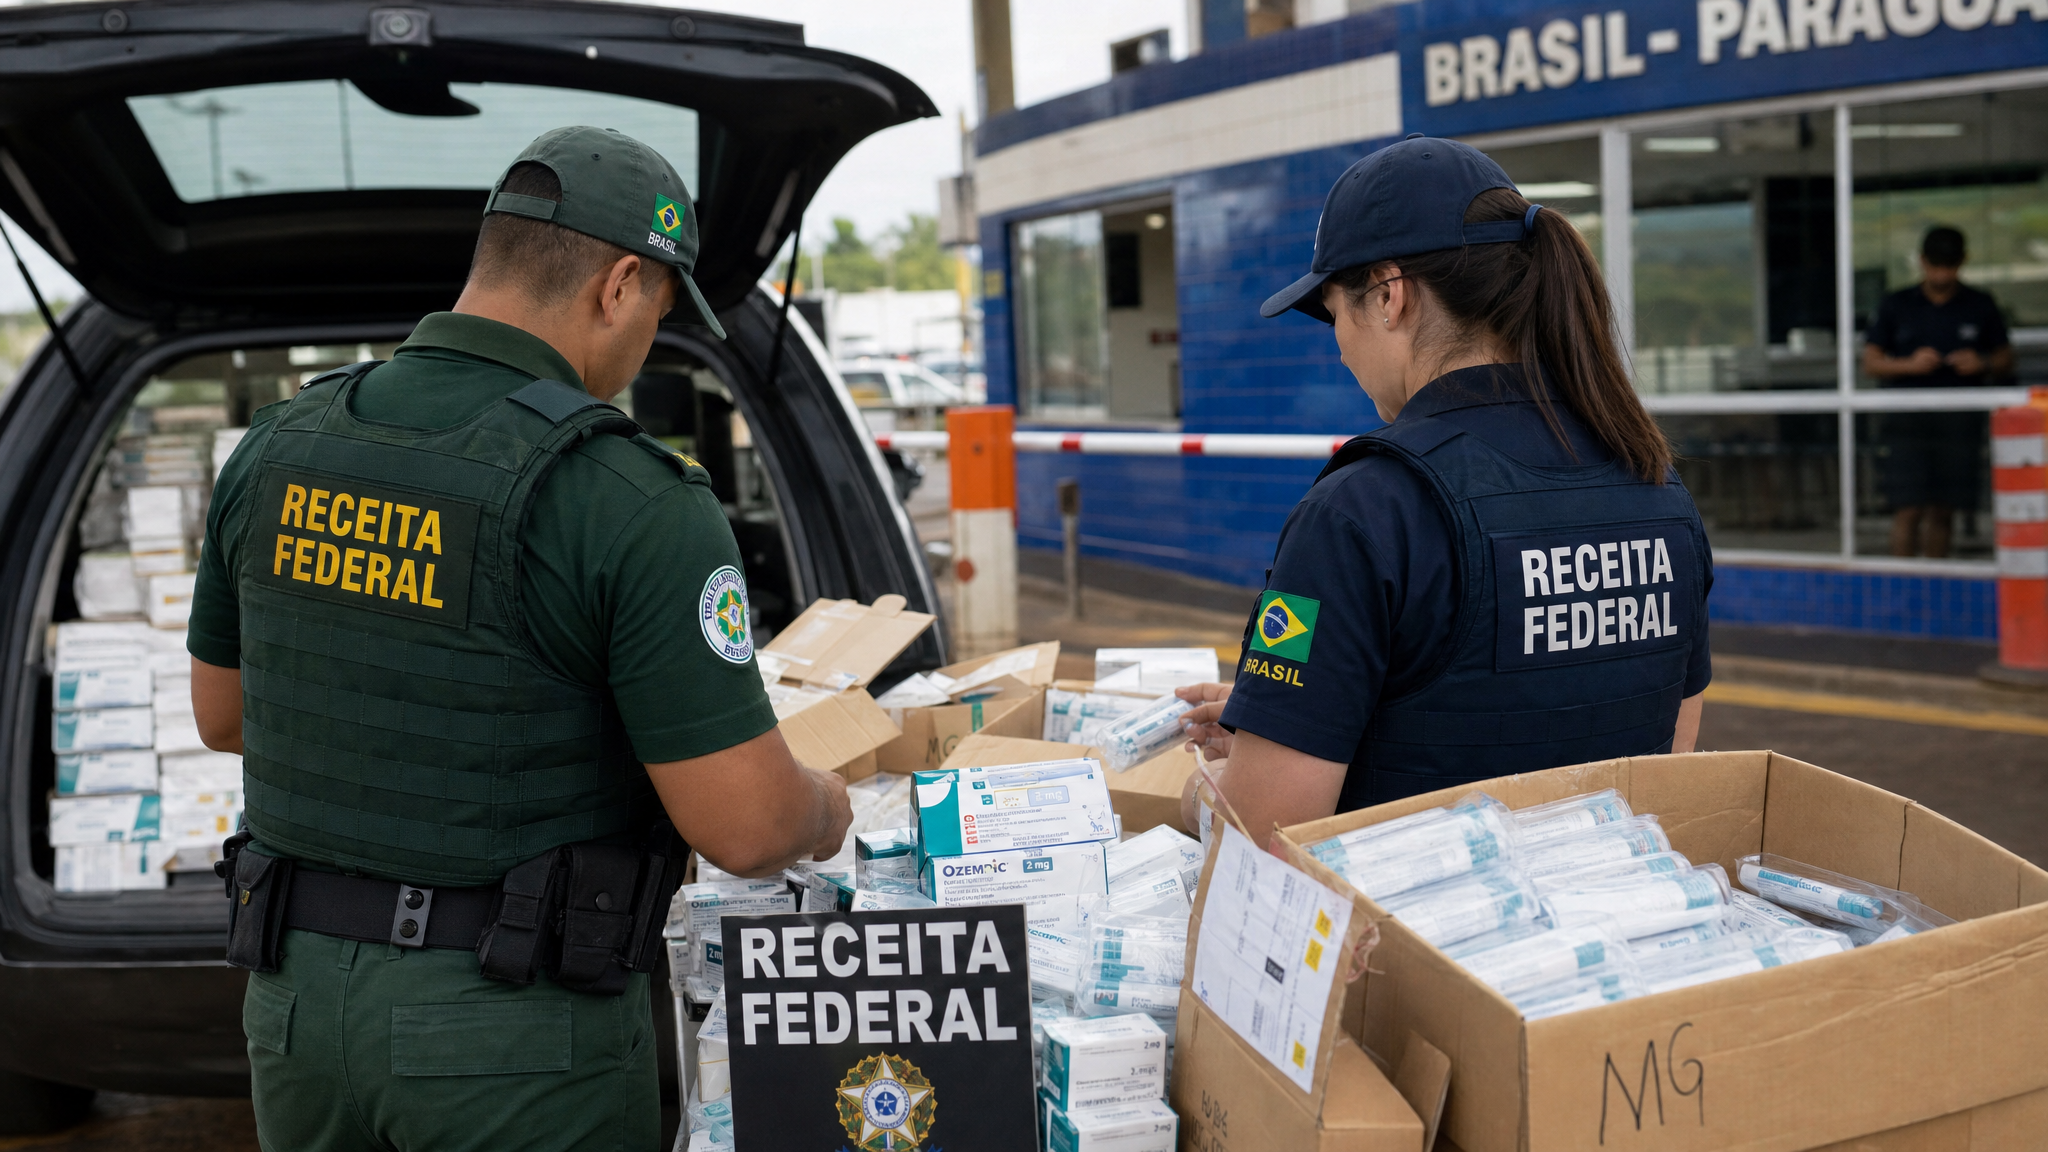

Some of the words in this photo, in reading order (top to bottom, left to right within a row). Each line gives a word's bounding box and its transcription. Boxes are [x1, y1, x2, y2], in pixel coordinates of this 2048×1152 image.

[647, 231, 676, 255] BRASIL
[280, 483, 442, 556] RECEITA
[273, 533, 444, 609] FEDERAL
[1521, 537, 1674, 598] RECEITA
[1523, 591, 1678, 655] FEDERAL
[1243, 657, 1304, 687] BRASIL
[1026, 861, 1034, 870] 2
[1034, 860, 1050, 871] mg
[740, 920, 1011, 979] RECEITA
[741, 987, 1018, 1045] FEDERAL
[1598, 1021, 1705, 1147] MG
